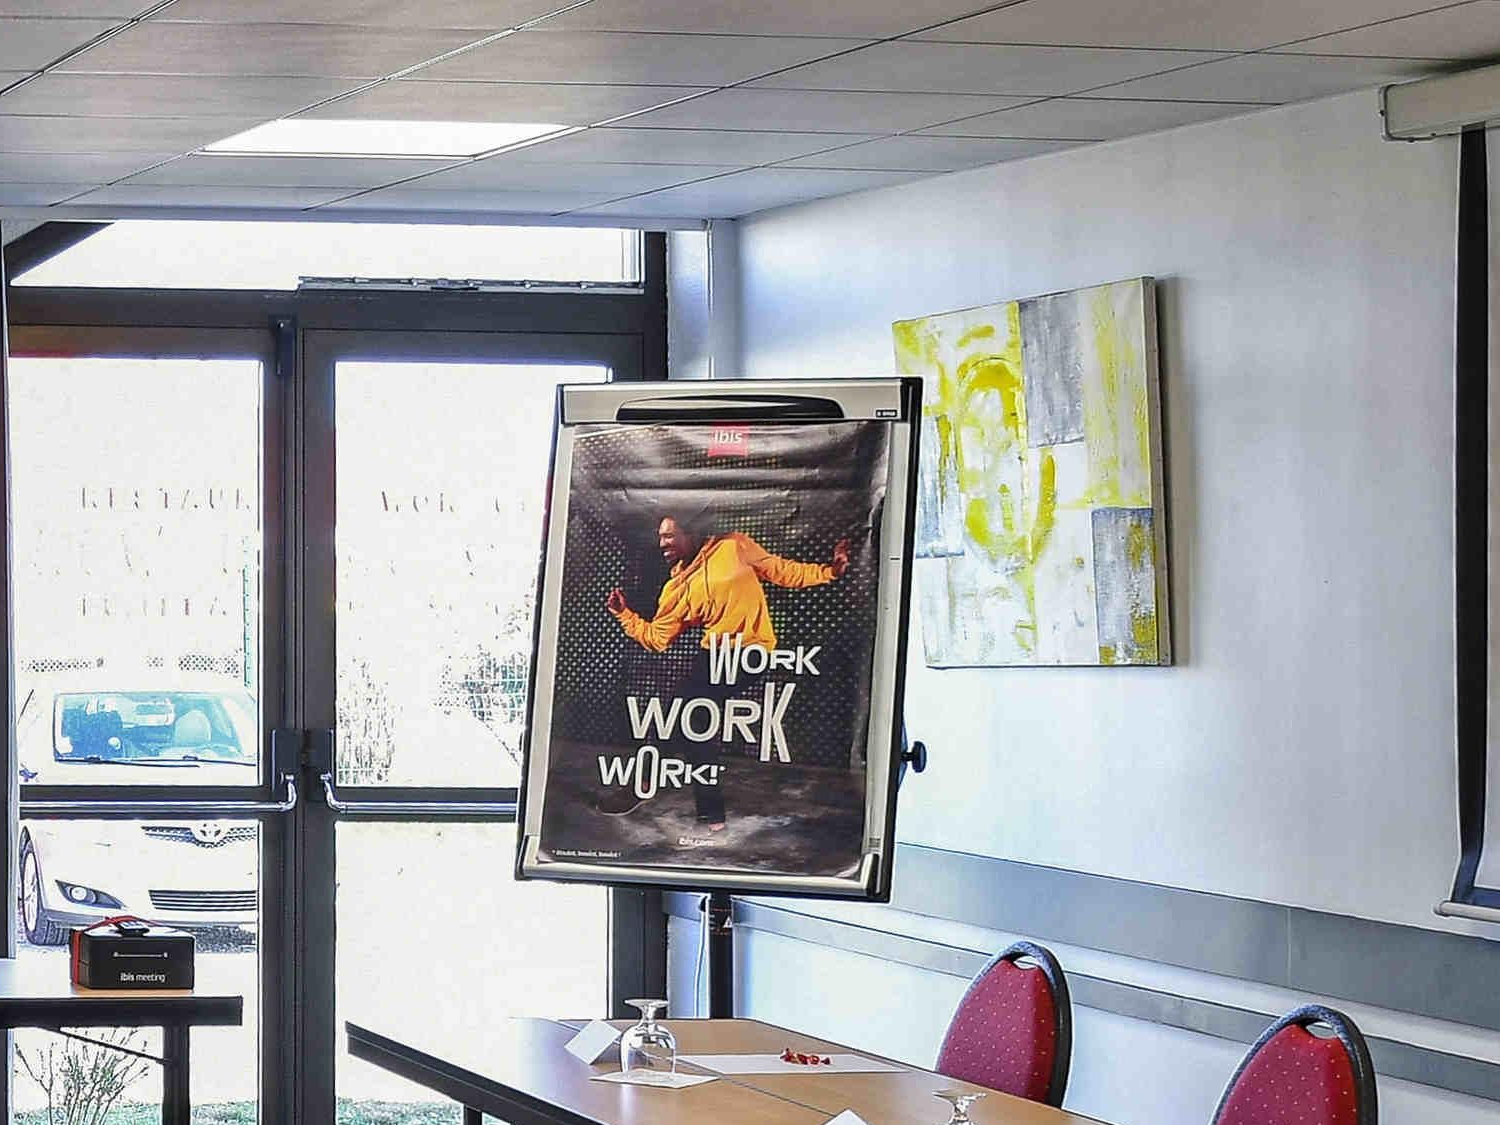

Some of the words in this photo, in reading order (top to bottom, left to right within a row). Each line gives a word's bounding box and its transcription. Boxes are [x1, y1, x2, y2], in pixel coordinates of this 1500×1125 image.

[714, 429, 743, 444] ibis
[709, 632, 822, 685] WORK
[626, 682, 796, 763] WORK
[136, 972, 165, 983] meeting
